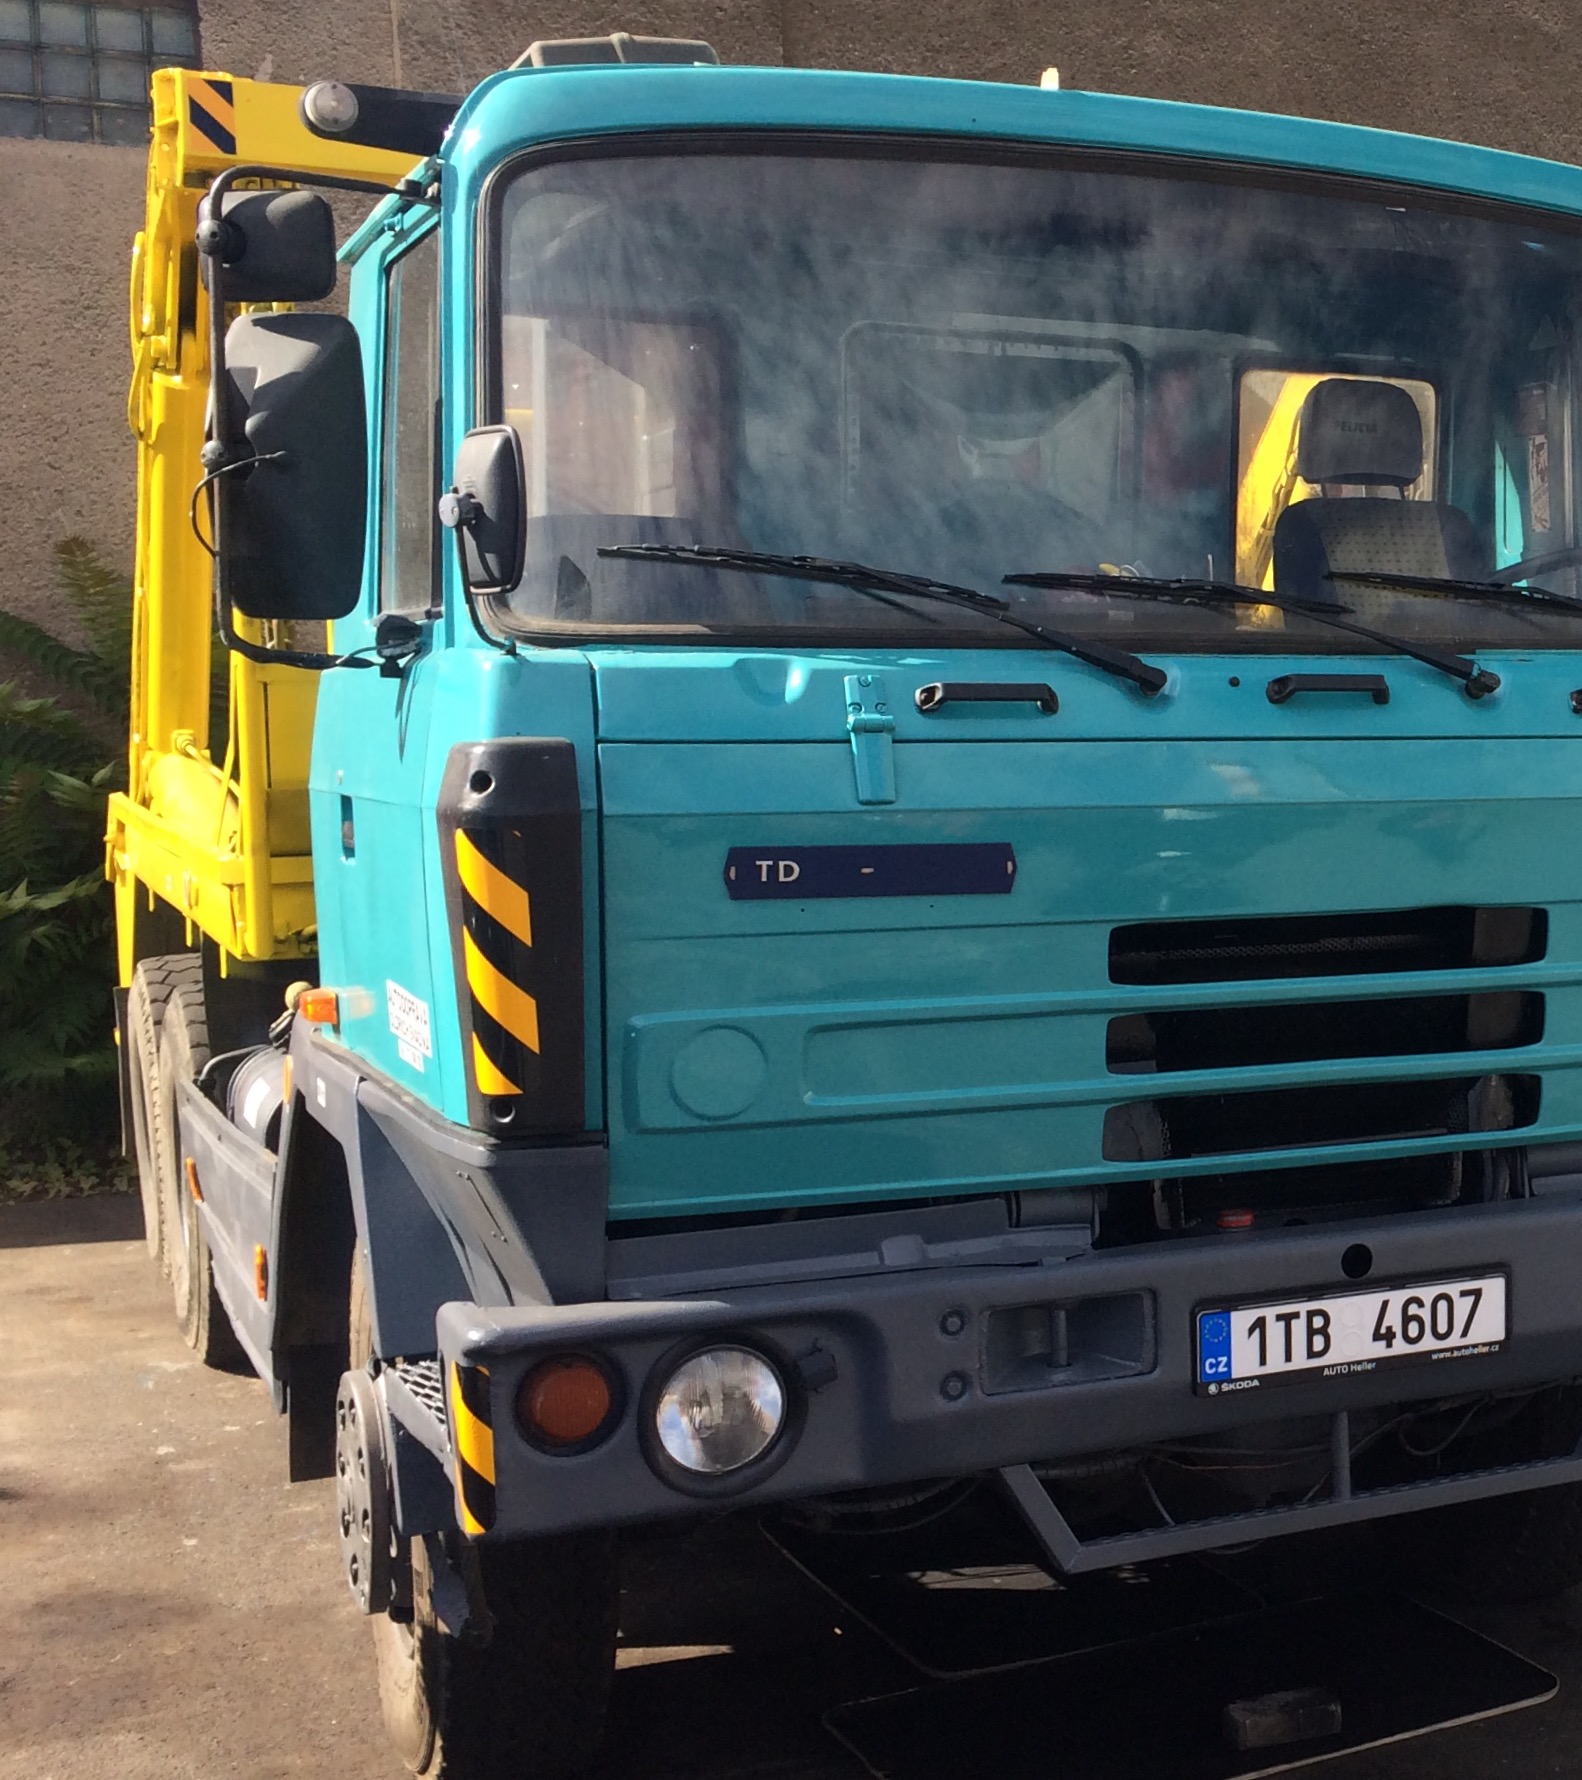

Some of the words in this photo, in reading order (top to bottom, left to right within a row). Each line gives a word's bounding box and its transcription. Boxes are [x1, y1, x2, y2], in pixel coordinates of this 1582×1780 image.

[755, 860, 800, 882] TD
[1247, 1308, 1331, 1367] 1TB
[1371, 1287, 1483, 1349] 4607
[1204, 1355, 1229, 1375] CZ
[1221, 1377, 1260, 1392] ŠKODA
[1323, 1364, 1349, 1376] AUTO
[1350, 1360, 1377, 1373] Heller
